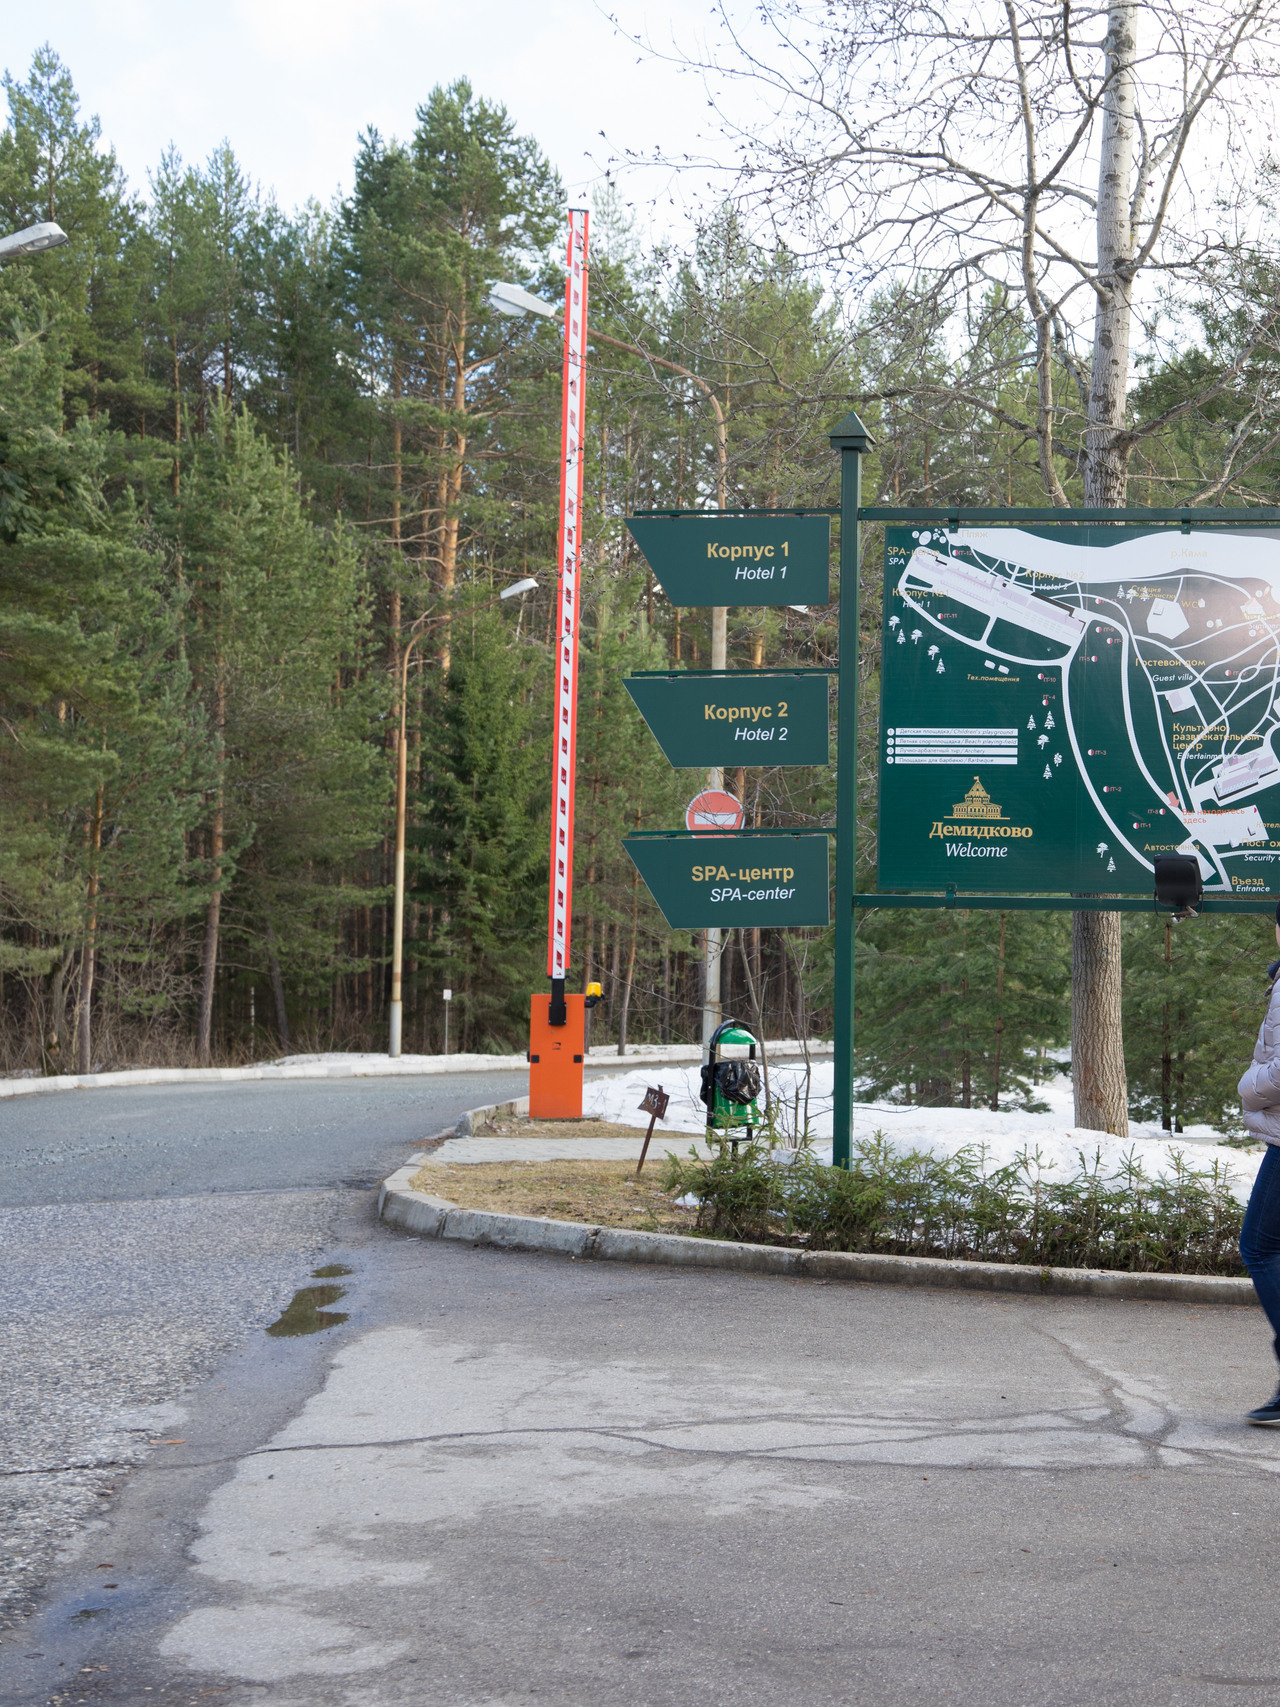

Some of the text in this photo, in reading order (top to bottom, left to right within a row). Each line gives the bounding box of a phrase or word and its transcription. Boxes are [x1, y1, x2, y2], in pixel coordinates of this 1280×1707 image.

[707, 541, 790, 563] Корпус 1
[735, 566, 787, 580] Hotel 1
[1181, 600, 1199, 609] WC
[1135, 657, 1206, 667] Гостевой дом
[1152, 673, 1194, 682] Guest villa
[704, 702, 788, 722] Корпус 2
[734, 728, 788, 741] Hotel 2
[1197, 808, 1246, 816] находитесь
[929, 821, 1033, 839] Демидково
[1241, 837, 1266, 847] Пост
[945, 842, 1008, 858] Welcome
[1243, 853, 1276, 863] Security
[691, 865, 795, 884] SPA-центр
[1231, 876, 1264, 887] Въезд
[1236, 884, 1271, 893] Entrance
[709, 887, 796, 903] SPA-center
